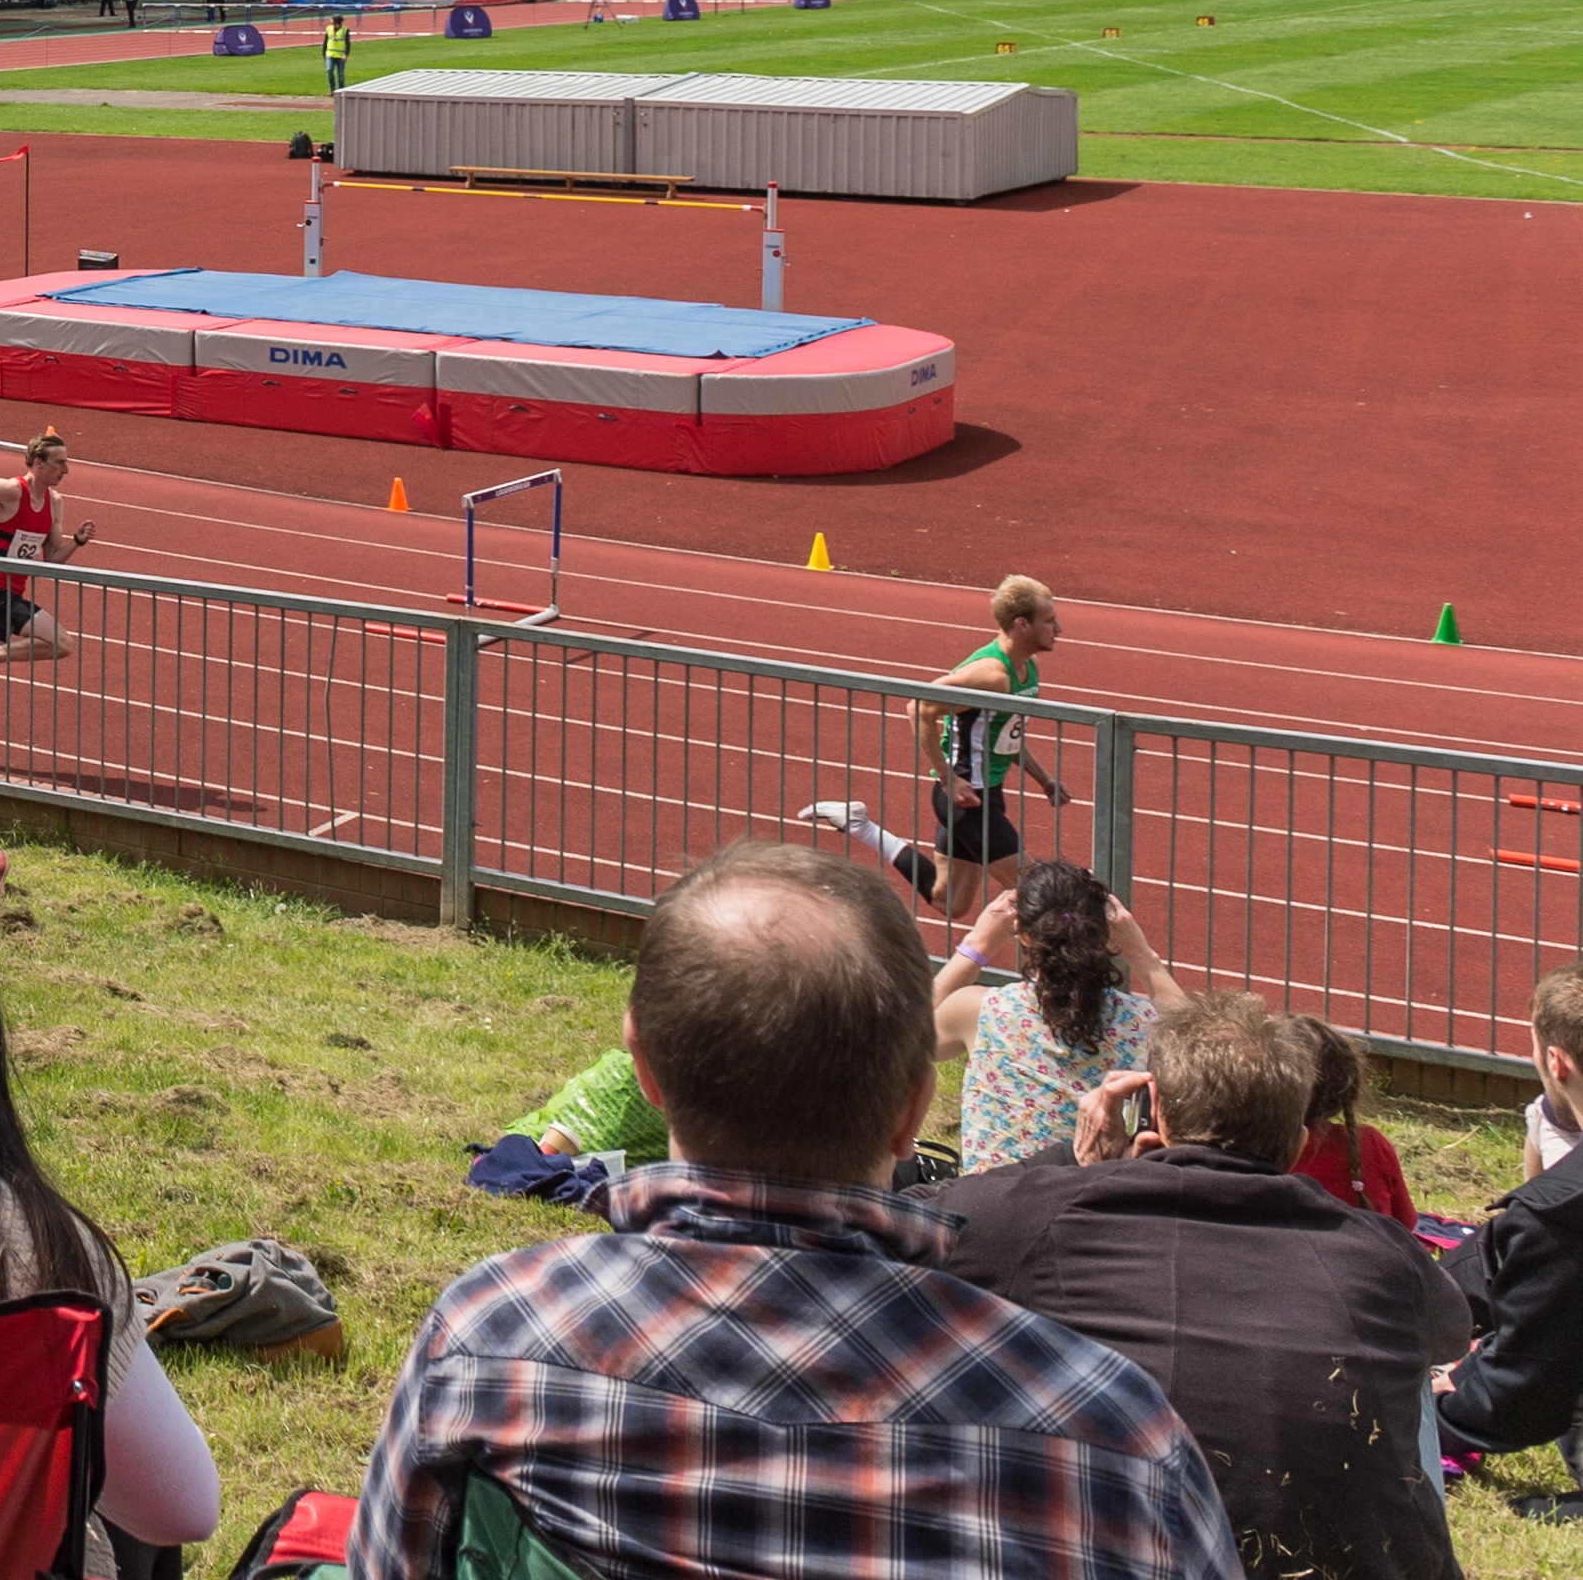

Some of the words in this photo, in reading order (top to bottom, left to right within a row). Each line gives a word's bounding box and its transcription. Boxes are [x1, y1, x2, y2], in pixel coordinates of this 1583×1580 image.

[269, 347, 347, 369] DIMA
[911, 363, 938, 387] DIMA
[17, 543, 37, 559] 62
